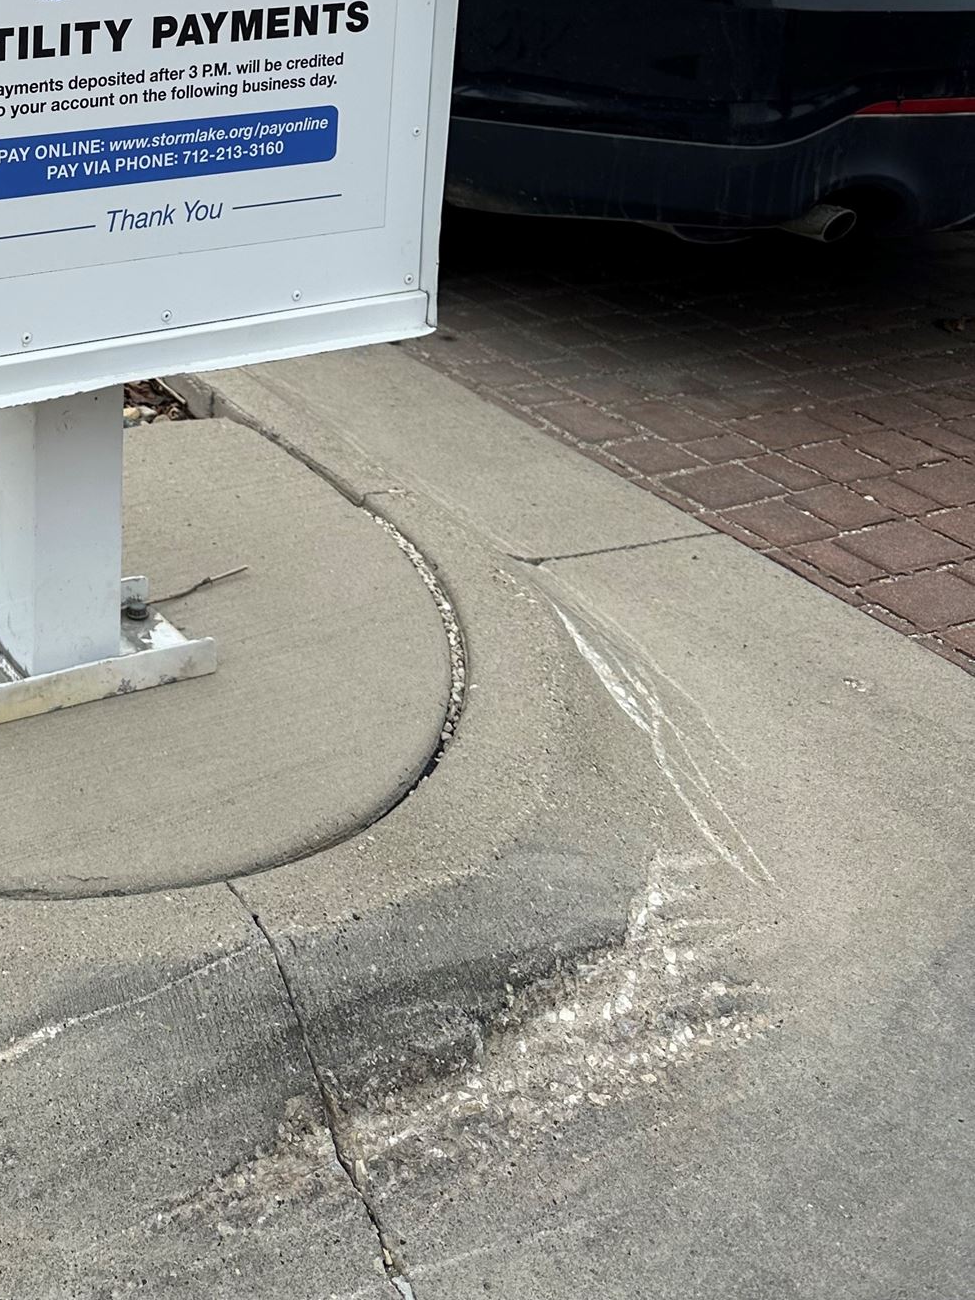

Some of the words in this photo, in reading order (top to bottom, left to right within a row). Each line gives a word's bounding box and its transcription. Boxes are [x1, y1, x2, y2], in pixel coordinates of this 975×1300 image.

[152, 0, 369, 49] PAYMENTS
[68, 70, 145, 91] deposited
[150, 67, 185, 83] after
[188, 65, 198, 79] 3
[202, 62, 232, 78] P.M.
[236, 59, 260, 75] will
[265, 56, 282, 72] be
[286, 52, 344, 70] credited
[11, 101, 47, 119] your
[51, 92, 115, 112] account
[119, 92, 138, 105] on
[143, 88, 166, 103] the
[171, 81, 238, 100] following
[243, 76, 305, 94] business
[309, 73, 337, 88] day.
[35, 139, 105, 160] ONLINE:
[109, 117, 329, 152] www.stormlake.org/payonline
[47, 163, 79, 180] PAY
[83, 160, 111, 176] VIA
[115, 153, 178, 172] PHONE:
[183, 140, 284, 165] 712-213-3160
[107, 203, 176, 233] Thank
[184, 200, 223, 223] You
